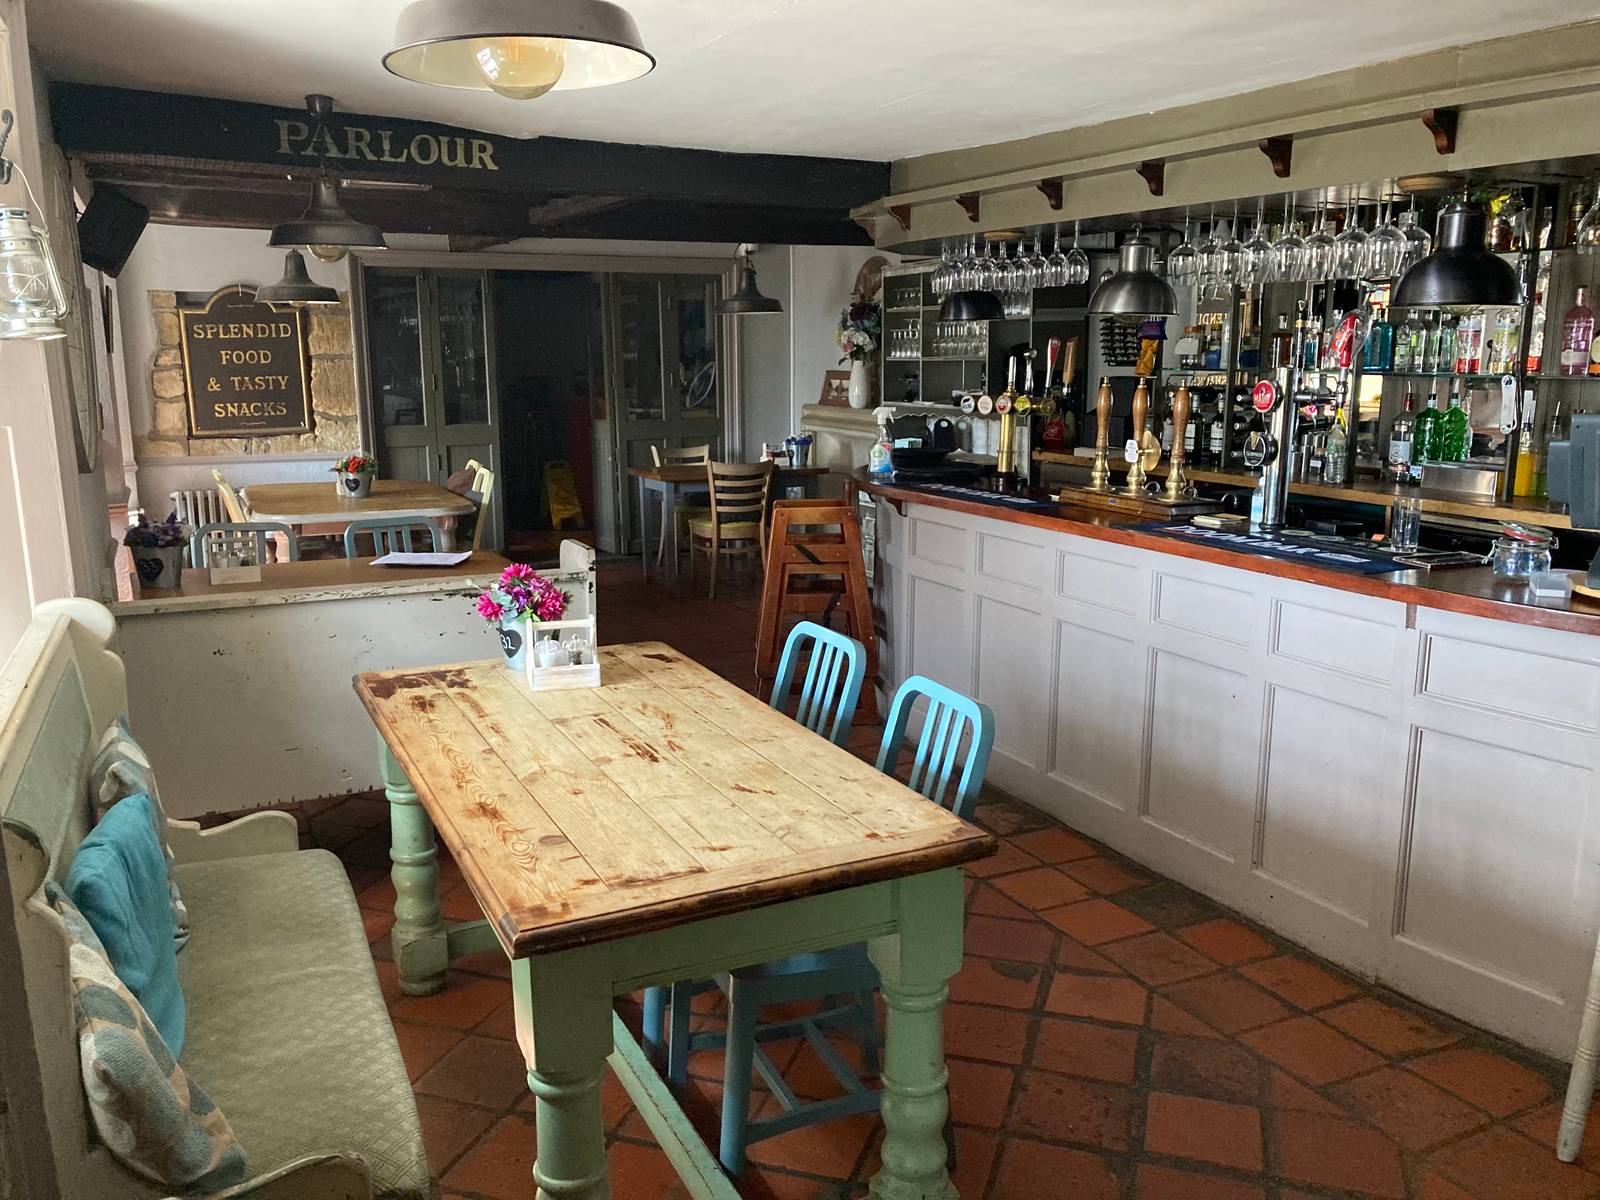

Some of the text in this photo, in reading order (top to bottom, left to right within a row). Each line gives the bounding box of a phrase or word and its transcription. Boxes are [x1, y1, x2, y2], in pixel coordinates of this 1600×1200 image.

[274, 119, 499, 170] PARLOUR
[193, 323, 292, 339] SPLENDID
[220, 350, 272, 365] FOOD
[207, 375, 289, 391] & TASTY
[214, 402, 287, 417] SNACKS
